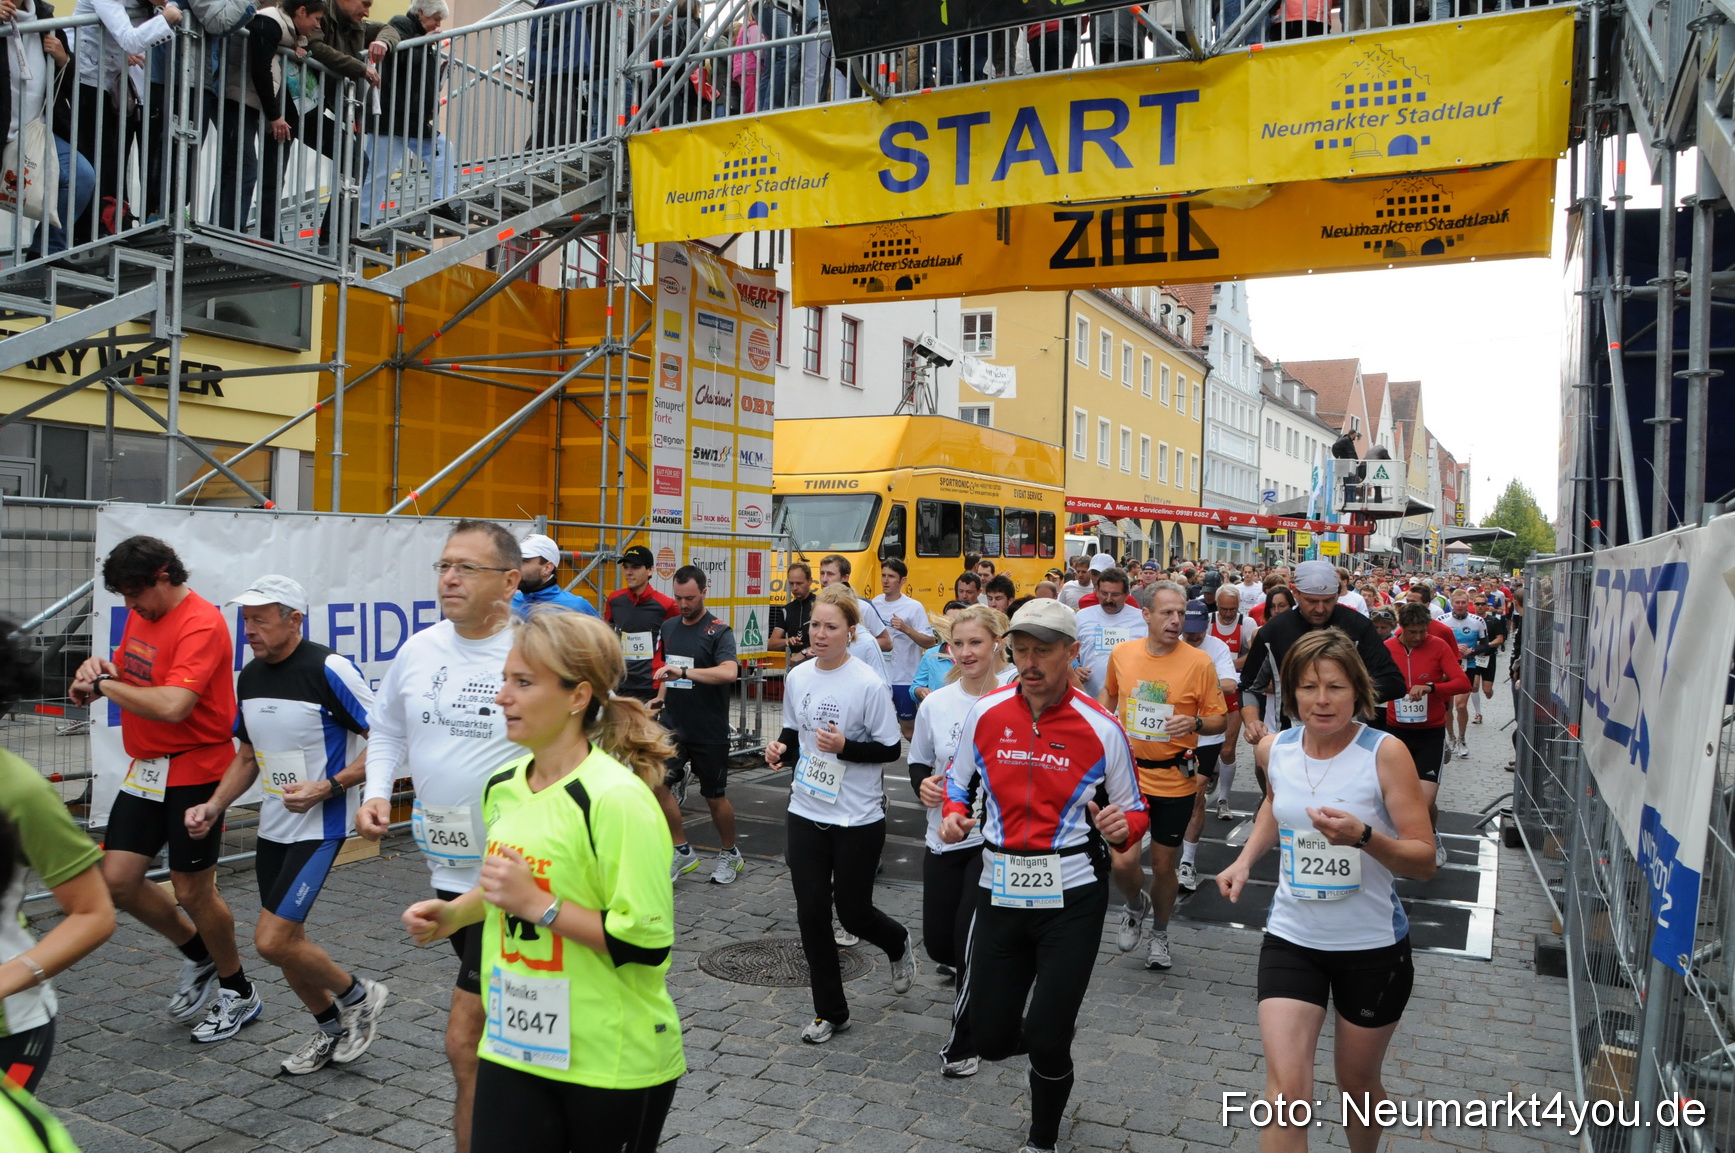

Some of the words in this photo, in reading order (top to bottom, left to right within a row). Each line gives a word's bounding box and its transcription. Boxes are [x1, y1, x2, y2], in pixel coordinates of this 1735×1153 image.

[1261, 109, 1389, 140] Neumarkter
[1395, 96, 1503, 126] Stadtlauf
[878, 89, 1200, 194] START
[665, 180, 752, 205] Neumarkter
[754, 172, 830, 195] Stadtlauf
[1320, 220, 1422, 239] Neumarkter
[1424, 208, 1510, 232] Stadtlauf
[1049, 201, 1219, 269] ZIEL
[821, 260, 898, 275] Neumarkter
[900, 253, 963, 270] Stadtlauf
[654, 396, 684, 413] Sinupret
[741, 395, 775, 416] OBI
[654, 411, 672, 424] forte
[803, 479, 859, 490] TIMING
[1013, 488, 1027, 499] EVENT
[1027, 490, 1043, 501] SERVICE
[1077, 501, 1101, 509] Service
[1116, 504, 1132, 512] Miet-
[1140, 506, 1175, 515] Serviceline:
[1176, 509, 1193, 517] 09181
[652, 515, 683, 525] HACKNER
[1282, 520, 1299, 528] 6352
[692, 557, 727, 574] Sinupret
[633, 643, 645, 652] 95
[1137, 703, 1156, 714] Erwin
[1402, 704, 1425, 713] 3130
[422, 711, 435, 725] 9.
[438, 717, 494, 730] Neumarkter
[1140, 717, 1164, 730] 437
[450, 727, 493, 740] Stadtlauf
[272, 772, 298, 785] 698
[806, 766, 836, 787] 3493
[428, 828, 469, 848] 2648
[1297, 836, 1327, 850] Maria
[1009, 854, 1048, 869] Wolfgang
[1300, 856, 1351, 877] 2248
[1010, 871, 1054, 888] 2223
[504, 978, 537, 1001] Monika
[506, 1006, 558, 1035] 2647
